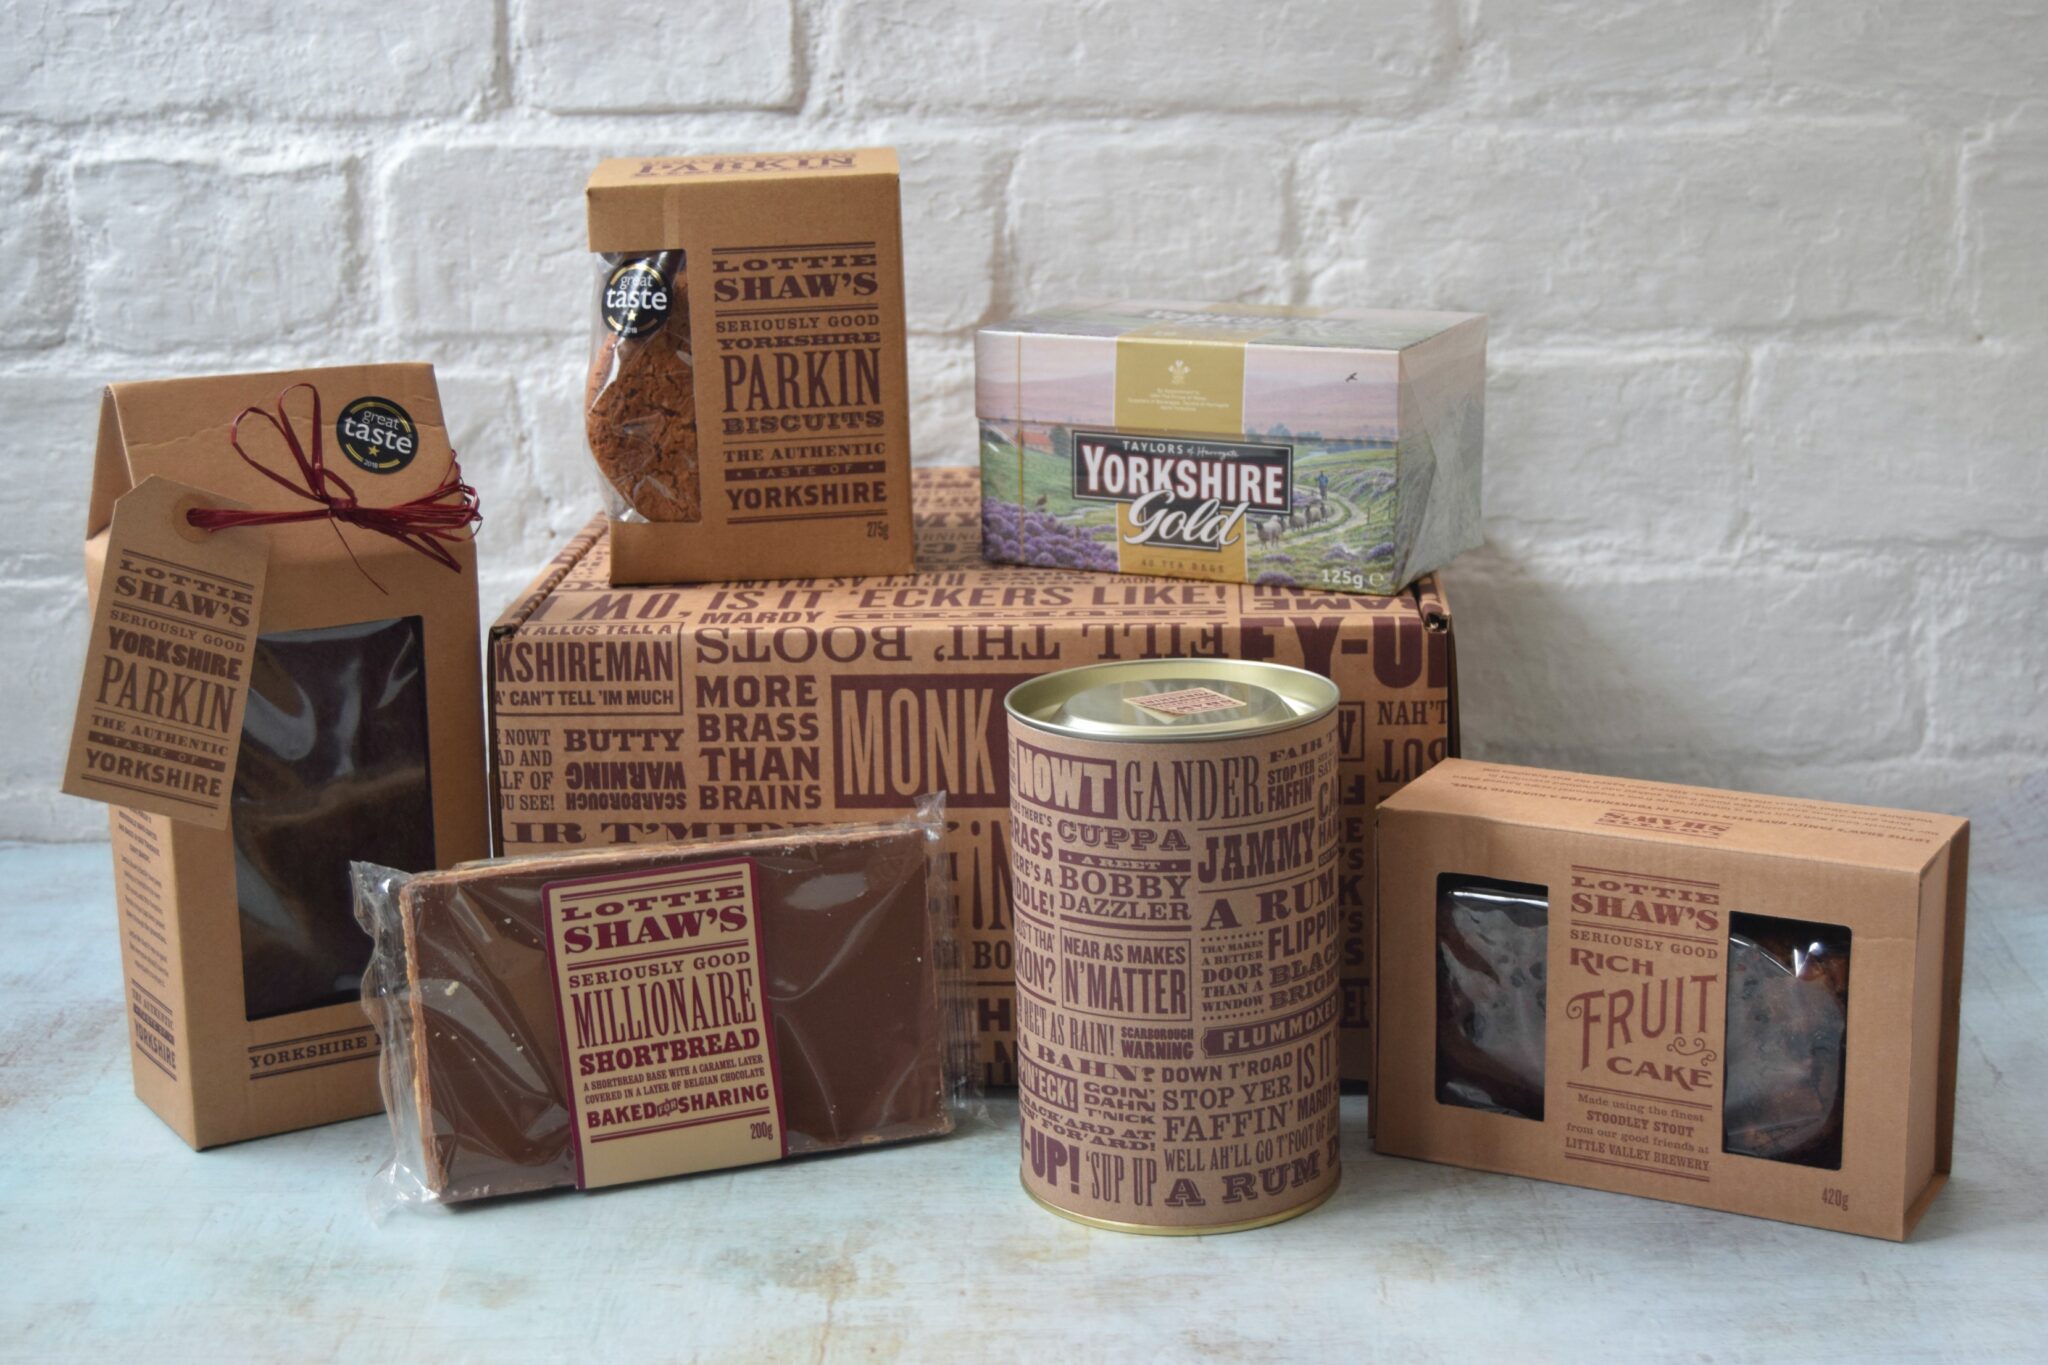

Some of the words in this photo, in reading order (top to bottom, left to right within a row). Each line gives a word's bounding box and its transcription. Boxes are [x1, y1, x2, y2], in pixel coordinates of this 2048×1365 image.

[634, 156, 856, 177] PARKIN
[712, 254, 877, 273] LOTTIE
[606, 288, 667, 310] taste
[714, 271, 878, 302] SHAW'S
[716, 317, 820, 333] SERIOUSLY
[828, 314, 879, 328] GOOD
[717, 332, 881, 350] YORKSHIRE
[721, 347, 881, 412] PARKIN
[361, 410, 400, 430] great
[722, 411, 884, 435] BISCUITS
[344, 417, 412, 454] taste
[1122, 441, 1183, 454] TAYLORS
[363, 459, 378, 469] 2018
[723, 446, 764, 462] THE
[771, 442, 885, 459] AUTHENTIC
[753, 465, 816, 478] TASTE
[830, 463, 853, 475] OF
[1081, 445, 1283, 505] YORKSHIRE
[726, 481, 886, 510] YORKSHIRE
[867, 521, 888, 540] 275g
[1123, 489, 1250, 545] Gold
[119, 559, 253, 604] LOTTIE
[1322, 569, 1364, 590] 125g
[115, 575, 251, 627] SHAW'S
[706, 591, 759, 610] IS
[777, 589, 825, 610] IT
[850, 587, 1073, 608] 'ECKERS
[1091, 586, 1228, 606] LIKE!
[110, 609, 197, 640] SERIOUSLY
[203, 632, 245, 653] GOOD
[536, 623, 599, 636] ALLUS
[605, 624, 647, 636] TELL
[655, 624, 672, 635] A
[698, 611, 824, 625] MARDY
[109, 626, 242, 681] YORKSHIRE
[694, 625, 912, 663] BOOTS
[1082, 622, 1229, 659] FILL
[96, 655, 237, 733] PARKIN
[510, 690, 555, 706] CAN'T
[559, 690, 595, 705] TELL
[599, 690, 623, 705] 'IM
[627, 690, 674, 705] MUCH
[695, 674, 818, 708] MORE
[91, 715, 125, 733] THE
[133, 723, 228, 756] AUTHENTIC
[505, 729, 551, 745] NOWT
[564, 729, 684, 751] BUTTY
[697, 712, 819, 742] BRASS
[114, 737, 168, 761] TASTE
[179, 752, 198, 764] OF
[840, 688, 995, 796] MONK
[1270, 738, 1322, 763] FAIR
[86, 748, 222, 798] YORKSHIRE
[520, 751, 552, 766] AND
[699, 747, 820, 781] THAN
[1267, 765, 1296, 785] STOP
[1299, 759, 1315, 777] YER
[530, 771, 553, 790] OF
[565, 761, 686, 790] WARNING
[1018, 745, 1112, 814] NOWT
[1124, 755, 1263, 822] GANDER
[520, 794, 554, 811] SEE!
[566, 793, 686, 811] SCARBOROUGH
[699, 785, 822, 810] BRAINS
[1268, 774, 1315, 813] FAFFIN'
[1021, 804, 1053, 827] THERE'S
[1057, 819, 1191, 851] CUPPA
[1198, 816, 1315, 883] JAMMY
[1044, 867, 1053, 887] A
[1059, 865, 1191, 899] BOBBY
[1571, 876, 1719, 905] LOTTIE
[561, 885, 745, 922] LOTTIE
[1059, 891, 1191, 920] DAZZLER
[1201, 898, 1242, 931] A
[1256, 866, 1335, 924] RUM
[1570, 892, 1719, 931] SHAW'S
[564, 905, 747, 955] SHAW'S
[1034, 927, 1055, 952] THA'
[1570, 929, 1663, 951] SERIOUSLY
[1670, 943, 1718, 959] GOOD
[1064, 936, 1099, 960] NEAR
[1104, 943, 1124, 962] AS
[1127, 947, 1186, 965] MAKES
[1201, 945, 1225, 954] THA'
[1228, 940, 1263, 951] MAKES
[1202, 958, 1210, 966] A
[1214, 951, 1264, 965] BETTER
[1570, 947, 1654, 976] RICH
[569, 960, 684, 988] SERIOUSLY
[694, 951, 750, 970] GOOD
[1202, 963, 1264, 983] DOOR
[1065, 958, 1187, 1014] N'MATTER
[1201, 982, 1248, 998] THAN
[1253, 980, 1264, 992] A
[571, 968, 756, 1049] MILLIONAIRE
[1202, 994, 1264, 1012] WINDOW
[1024, 996, 1046, 1039] REET
[1050, 1012, 1065, 1046] AS
[1070, 1017, 1114, 1056] RAIN!
[1121, 1027, 1194, 1040] SCARBOROUGH
[1566, 974, 1718, 1072] FRUIT
[135, 1019, 176, 1069] YORKSHIRE
[250, 1036, 368, 1068] YORKSHIRE
[579, 1028, 760, 1076] SHORTBREAD
[1121, 1039, 1193, 1060] WARNING
[583, 1081, 589, 1091] A
[591, 1074, 644, 1090] SHORTBREAD
[647, 1071, 667, 1083] BASE
[669, 1067, 690, 1079] WITH
[692, 1066, 698, 1075] A
[700, 1060, 737, 1073] CARAMEL
[739, 1055, 763, 1067] LAYER
[1038, 1043, 1155, 1082] BAHN?
[1162, 1065, 1222, 1083] DOWN
[1228, 1051, 1293, 1079] T'ROAD
[1297, 1043, 1315, 1092] IS
[1320, 1031, 1332, 1081] IT
[1606, 1056, 1713, 1091] CAKE
[585, 1090, 622, 1104] COVERED
[625, 1089, 633, 1098] IN
[635, 1087, 641, 1097] A
[642, 1083, 669, 1095] LAYER
[671, 1080, 681, 1090] OF
[684, 1075, 718, 1089] BELGIAN
[720, 1067, 765, 1083] CHOCOLATE
[1084, 1081, 1155, 1099] GOIN'
[1162, 1087, 1235, 1110] STOP
[1241, 1075, 1293, 1105] YER
[587, 1100, 657, 1128] BAKED
[657, 1100, 678, 1117] FOR
[678, 1083, 769, 1113] SHARING
[1084, 1094, 1155, 1112] DAHN
[1084, 1107, 1155, 1124] T'NICK
[1577, 1093, 1608, 1107] Made
[1613, 1097, 1645, 1114] using
[1649, 1101, 1667, 1115] the
[1672, 1108, 1704, 1121] finest
[750, 1122, 773, 1140] 200g
[1121, 1129, 1155, 1139] AT
[1162, 1100, 1294, 1142] FAFFIN'
[1587, 1110, 1649, 1130] STOODLEY
[1654, 1121, 1694, 1138] STOUT
[1165, 1148, 1206, 1172] WELL
[1210, 1143, 1252, 1171] AH'LL
[1256, 1138, 1273, 1164] GO
[1277, 1123, 1314, 1158] T'FOOT
[1566, 1123, 1593, 1136] from
[1598, 1128, 1618, 1138] our
[1621, 1130, 1649, 1145] good
[1653, 1136, 1695, 1151] friends
[1698, 1146, 1709, 1154] at
[1566, 1137, 1605, 1154] LITTLE
[1609, 1144, 1649, 1161] VALLEY
[1654, 1151, 1709, 1172] BREWERY
[1086, 1151, 1124, 1203] 'SUP
[1132, 1157, 1157, 1207] UP
[1165, 1178, 1206, 1207] A
[1222, 1150, 1320, 1204] RUM
[1822, 1187, 1849, 1211] 420g
